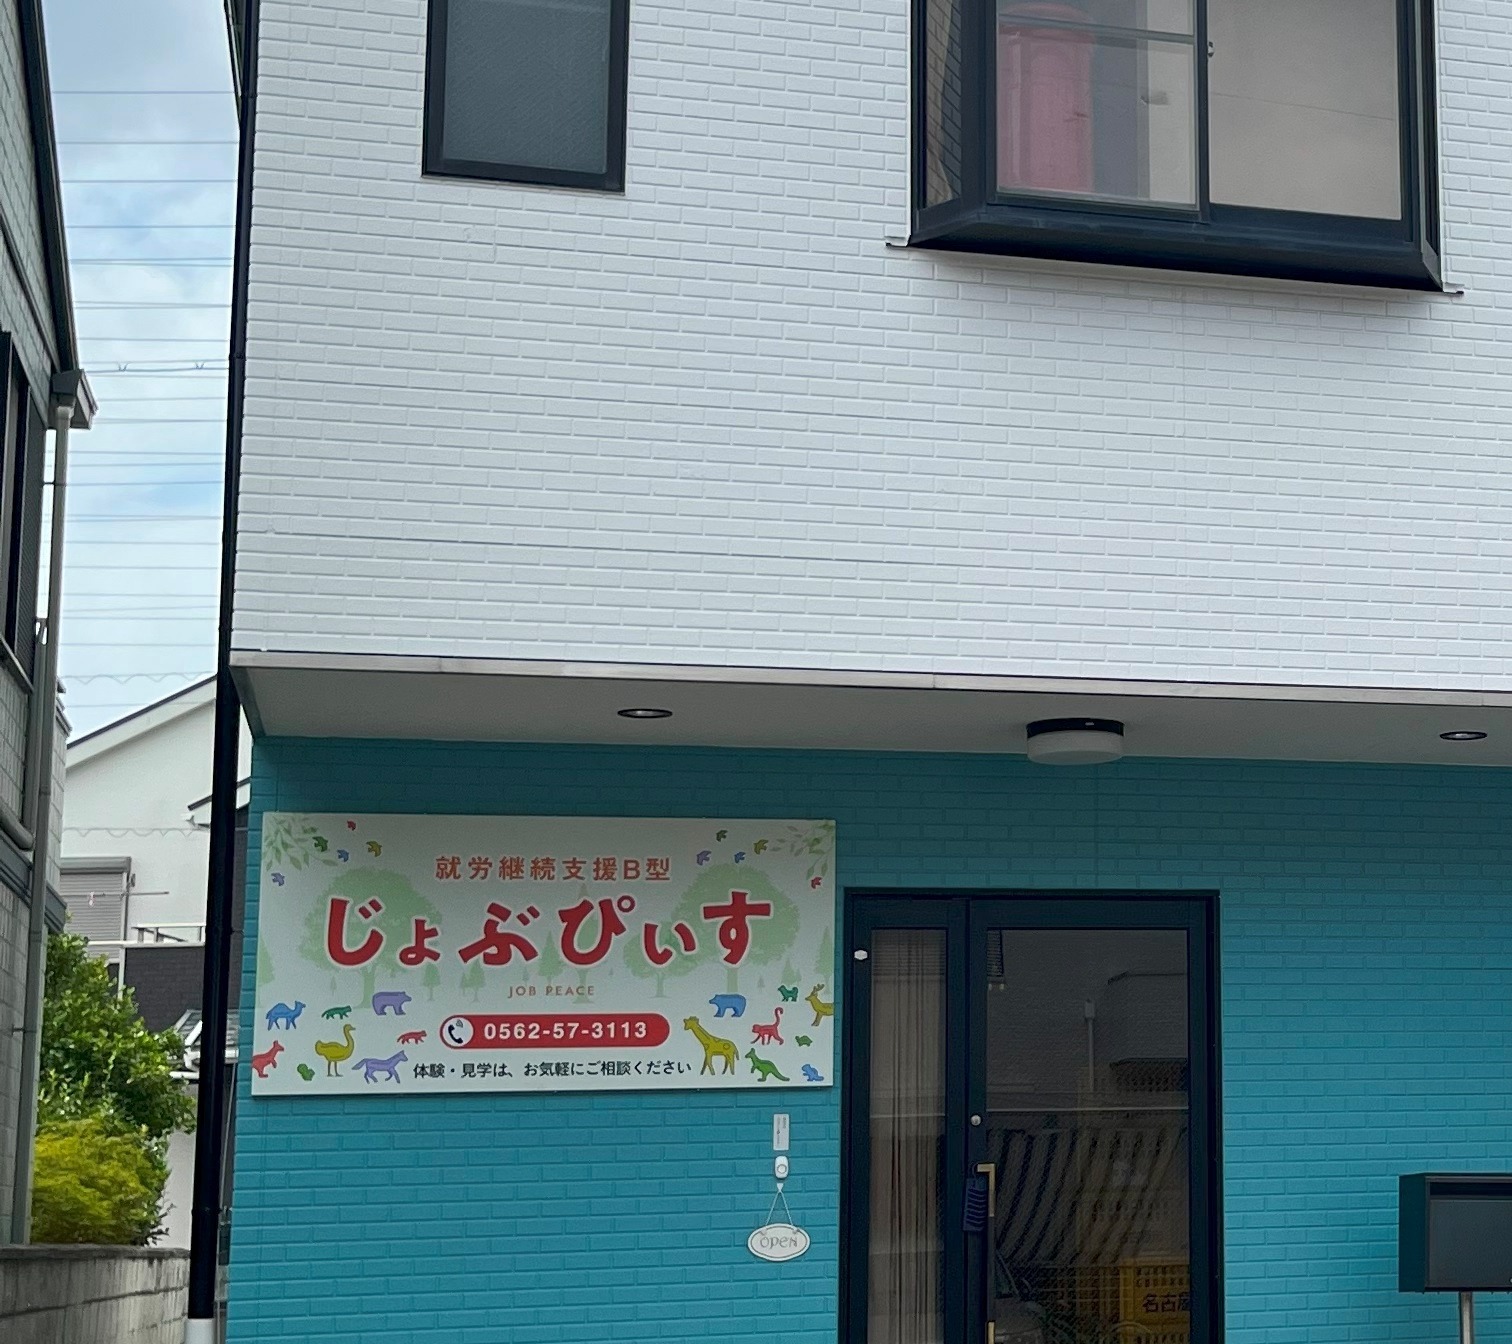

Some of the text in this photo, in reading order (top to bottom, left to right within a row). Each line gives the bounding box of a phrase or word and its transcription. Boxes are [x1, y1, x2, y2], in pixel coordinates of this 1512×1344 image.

[435, 855, 671, 882] 就労継続支援B型
[326, 890, 772, 966] じょぶぴぃす
[507, 985, 595, 999] JOB PEACE
[483, 1021, 648, 1040] 0562-57-3113
[412, 1060, 692, 1079] 体験・見学は、お気軽にご相談ください
